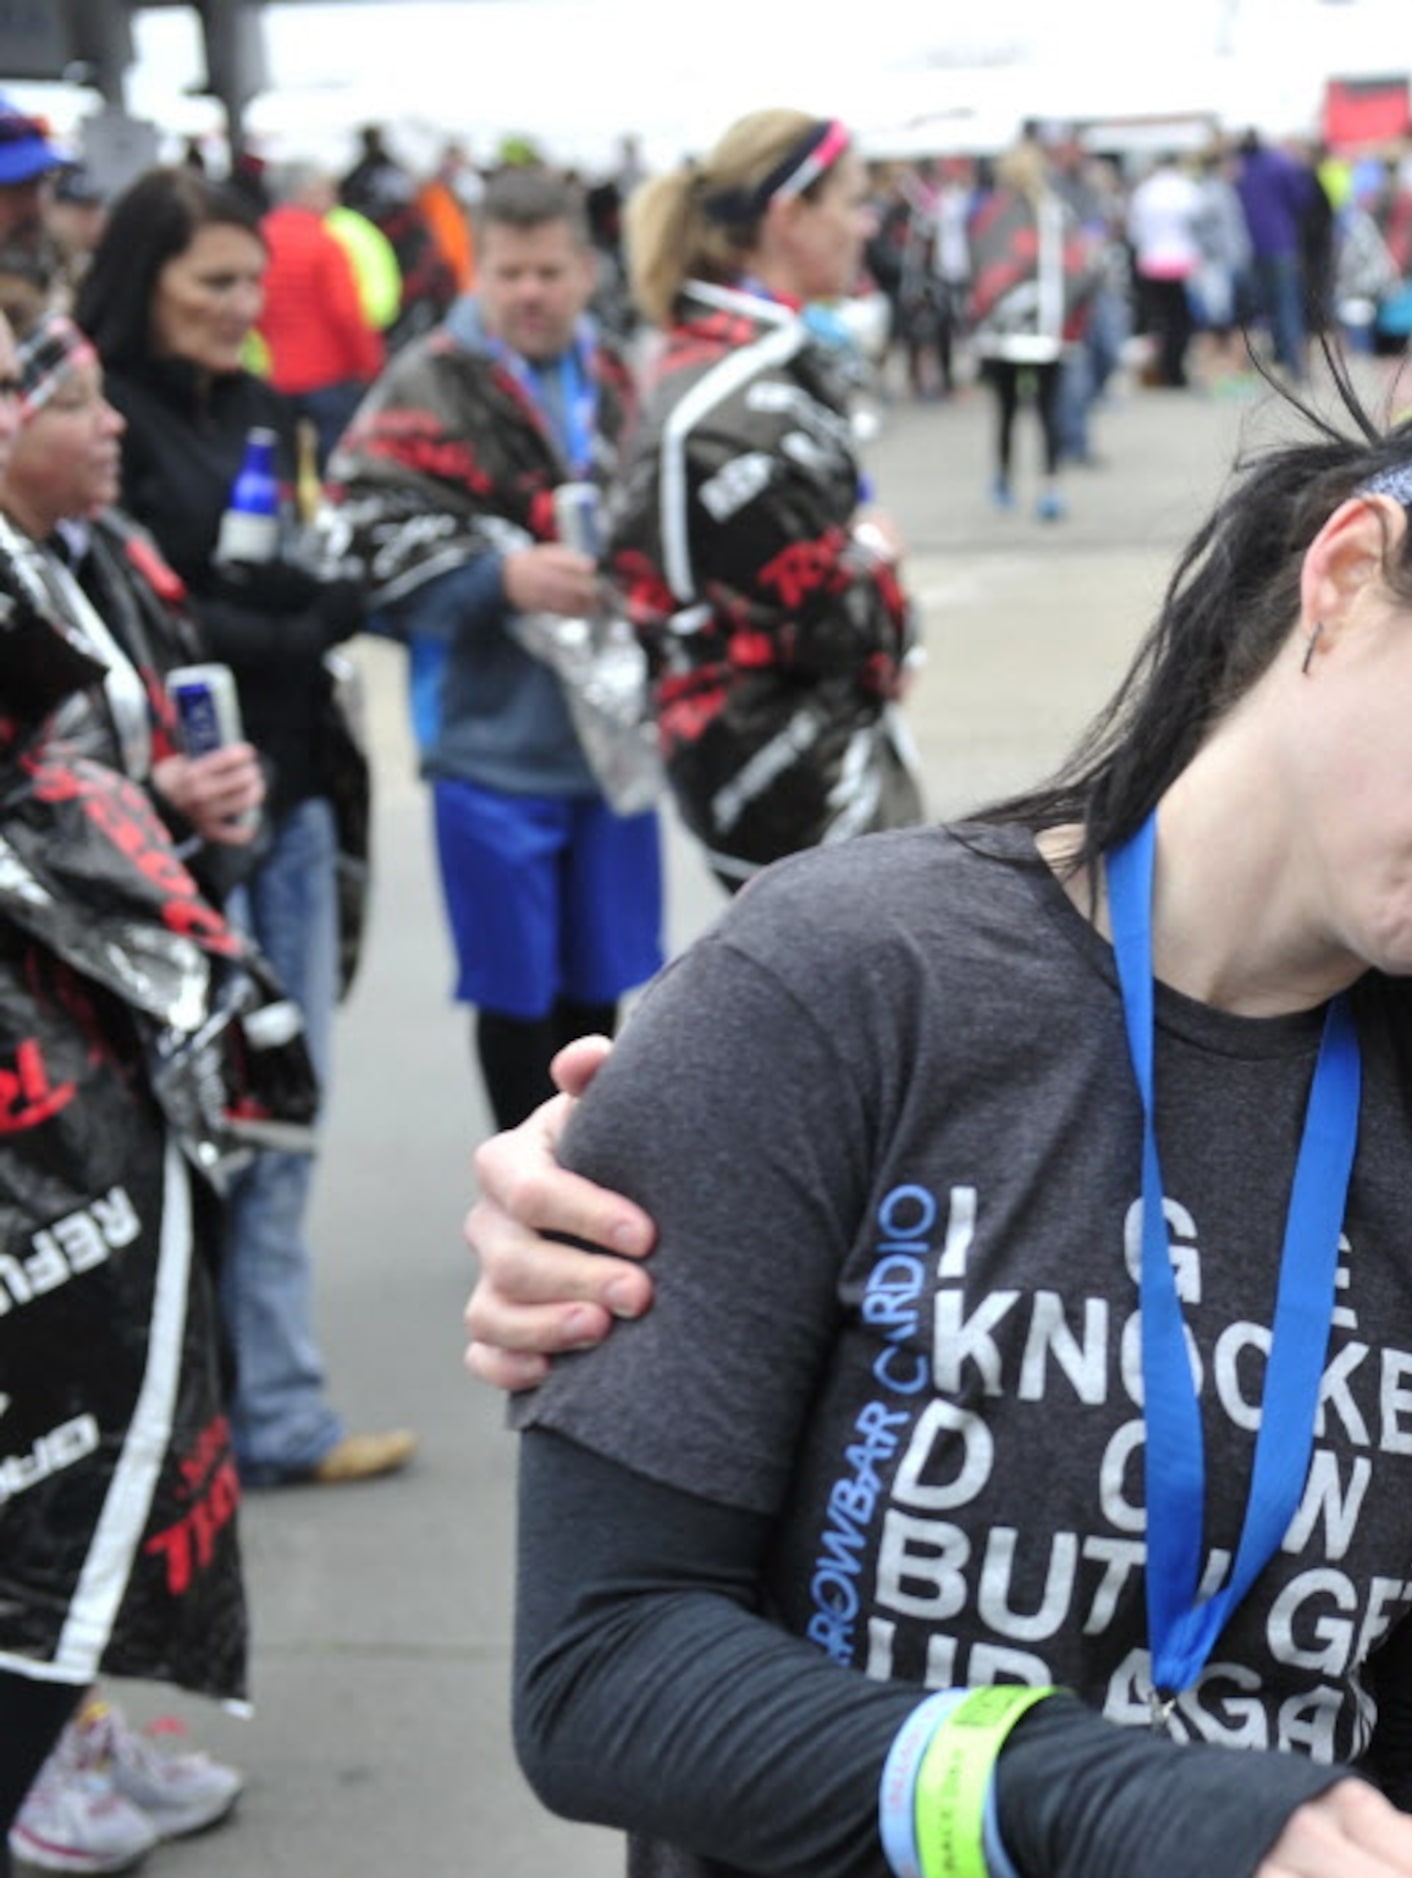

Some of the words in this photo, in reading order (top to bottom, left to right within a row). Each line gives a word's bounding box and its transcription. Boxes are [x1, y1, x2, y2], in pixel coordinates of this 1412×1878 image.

[936, 1186, 977, 1278] I
[806, 1401, 910, 1668] ROWBAR
[875, 1509, 1147, 1643] BUT
